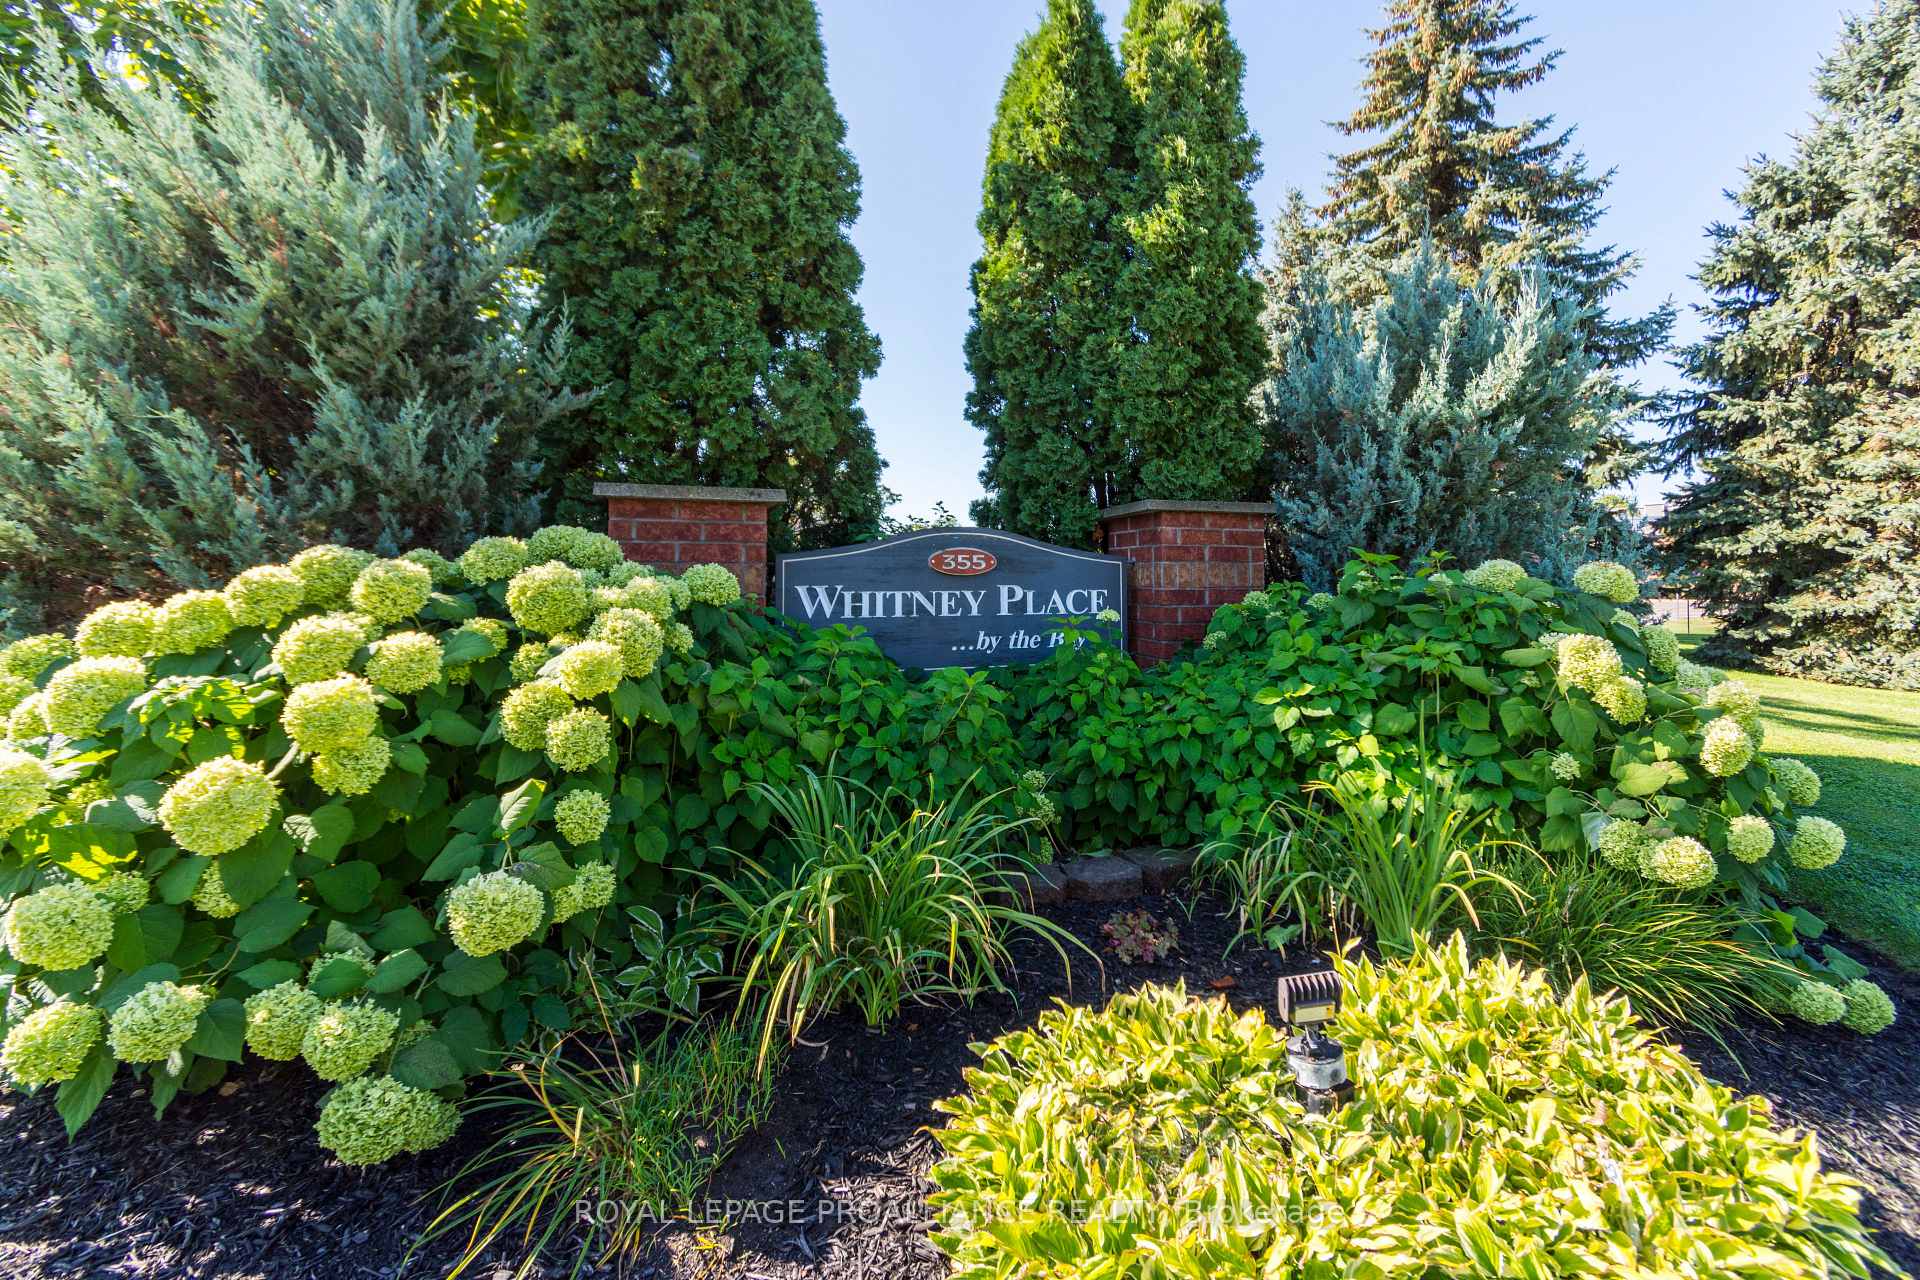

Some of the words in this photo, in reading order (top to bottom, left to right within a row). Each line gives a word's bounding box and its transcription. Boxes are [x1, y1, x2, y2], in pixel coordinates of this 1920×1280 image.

[942, 554, 986, 570] 355
[795, 584, 987, 619] WHITNEY
[996, 584, 1108, 615] PLACE
[1008, 629, 1041, 649] the
[1048, 631, 1086, 651] By
